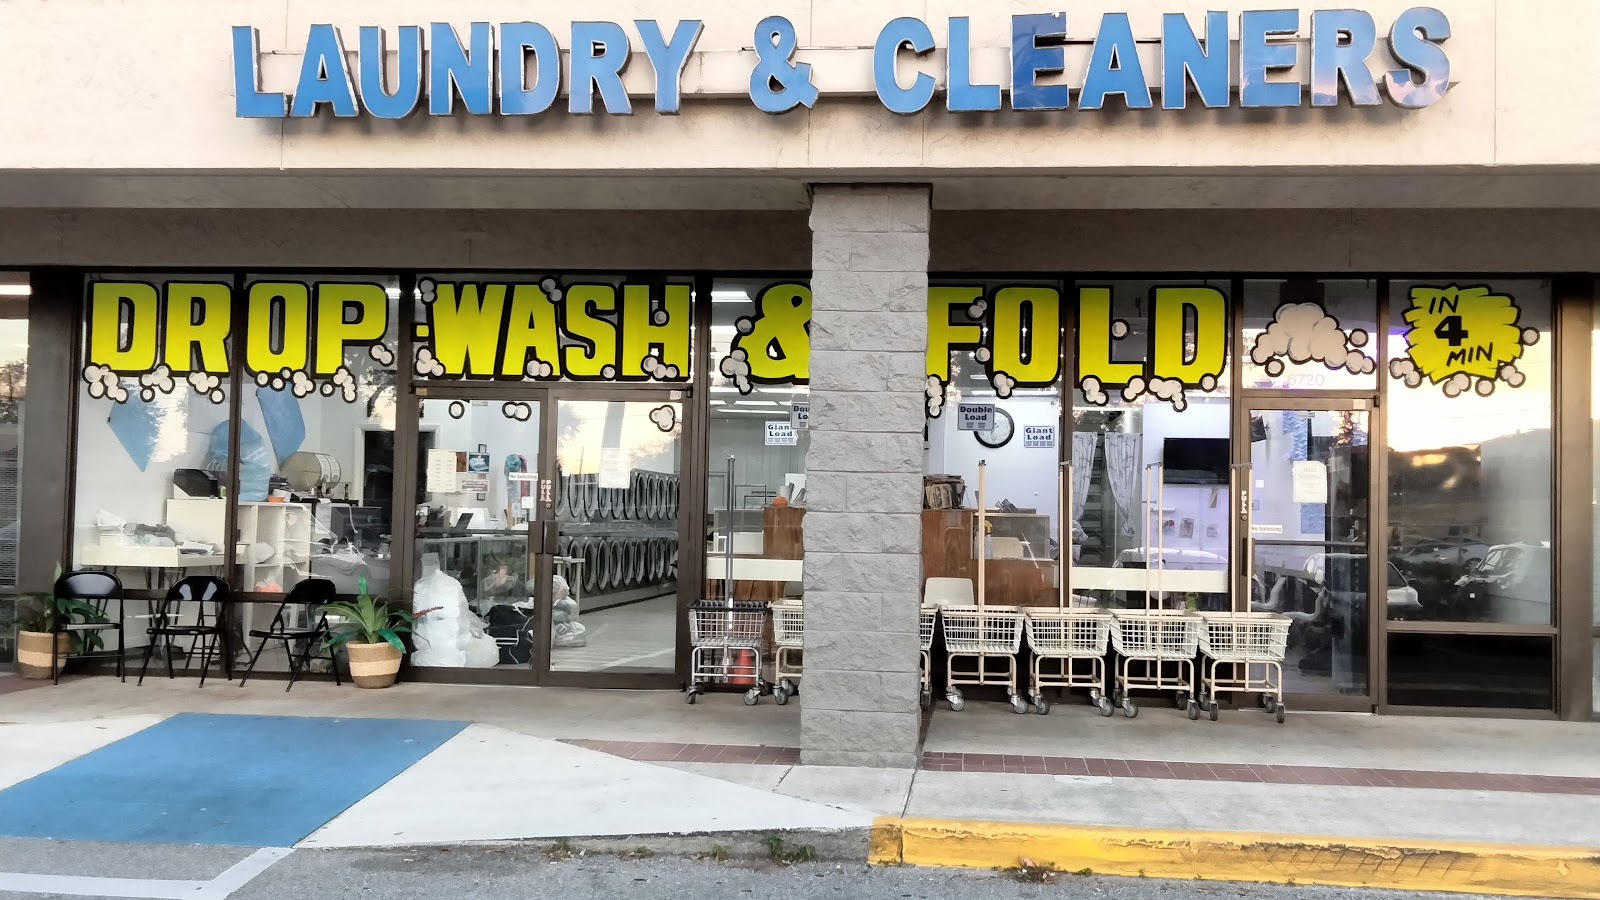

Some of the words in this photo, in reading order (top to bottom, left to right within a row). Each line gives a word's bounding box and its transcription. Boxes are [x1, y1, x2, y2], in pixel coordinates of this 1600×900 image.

[231, 19, 704, 118] LAUNDRY
[748, 15, 820, 114] &
[873, 6, 1452, 112] CLEANERS
[1428, 295, 1459, 315] IN
[732, 281, 811, 384] &
[927, 284, 1229, 388] FOLD
[1434, 315, 1469, 347] 4
[1446, 342, 1493, 367] MIN
[793, 405, 810, 413] Dou
[960, 405, 993, 413] Double
[965, 413, 988, 421] Load
[1240, 490, 1248, 513] PULL
